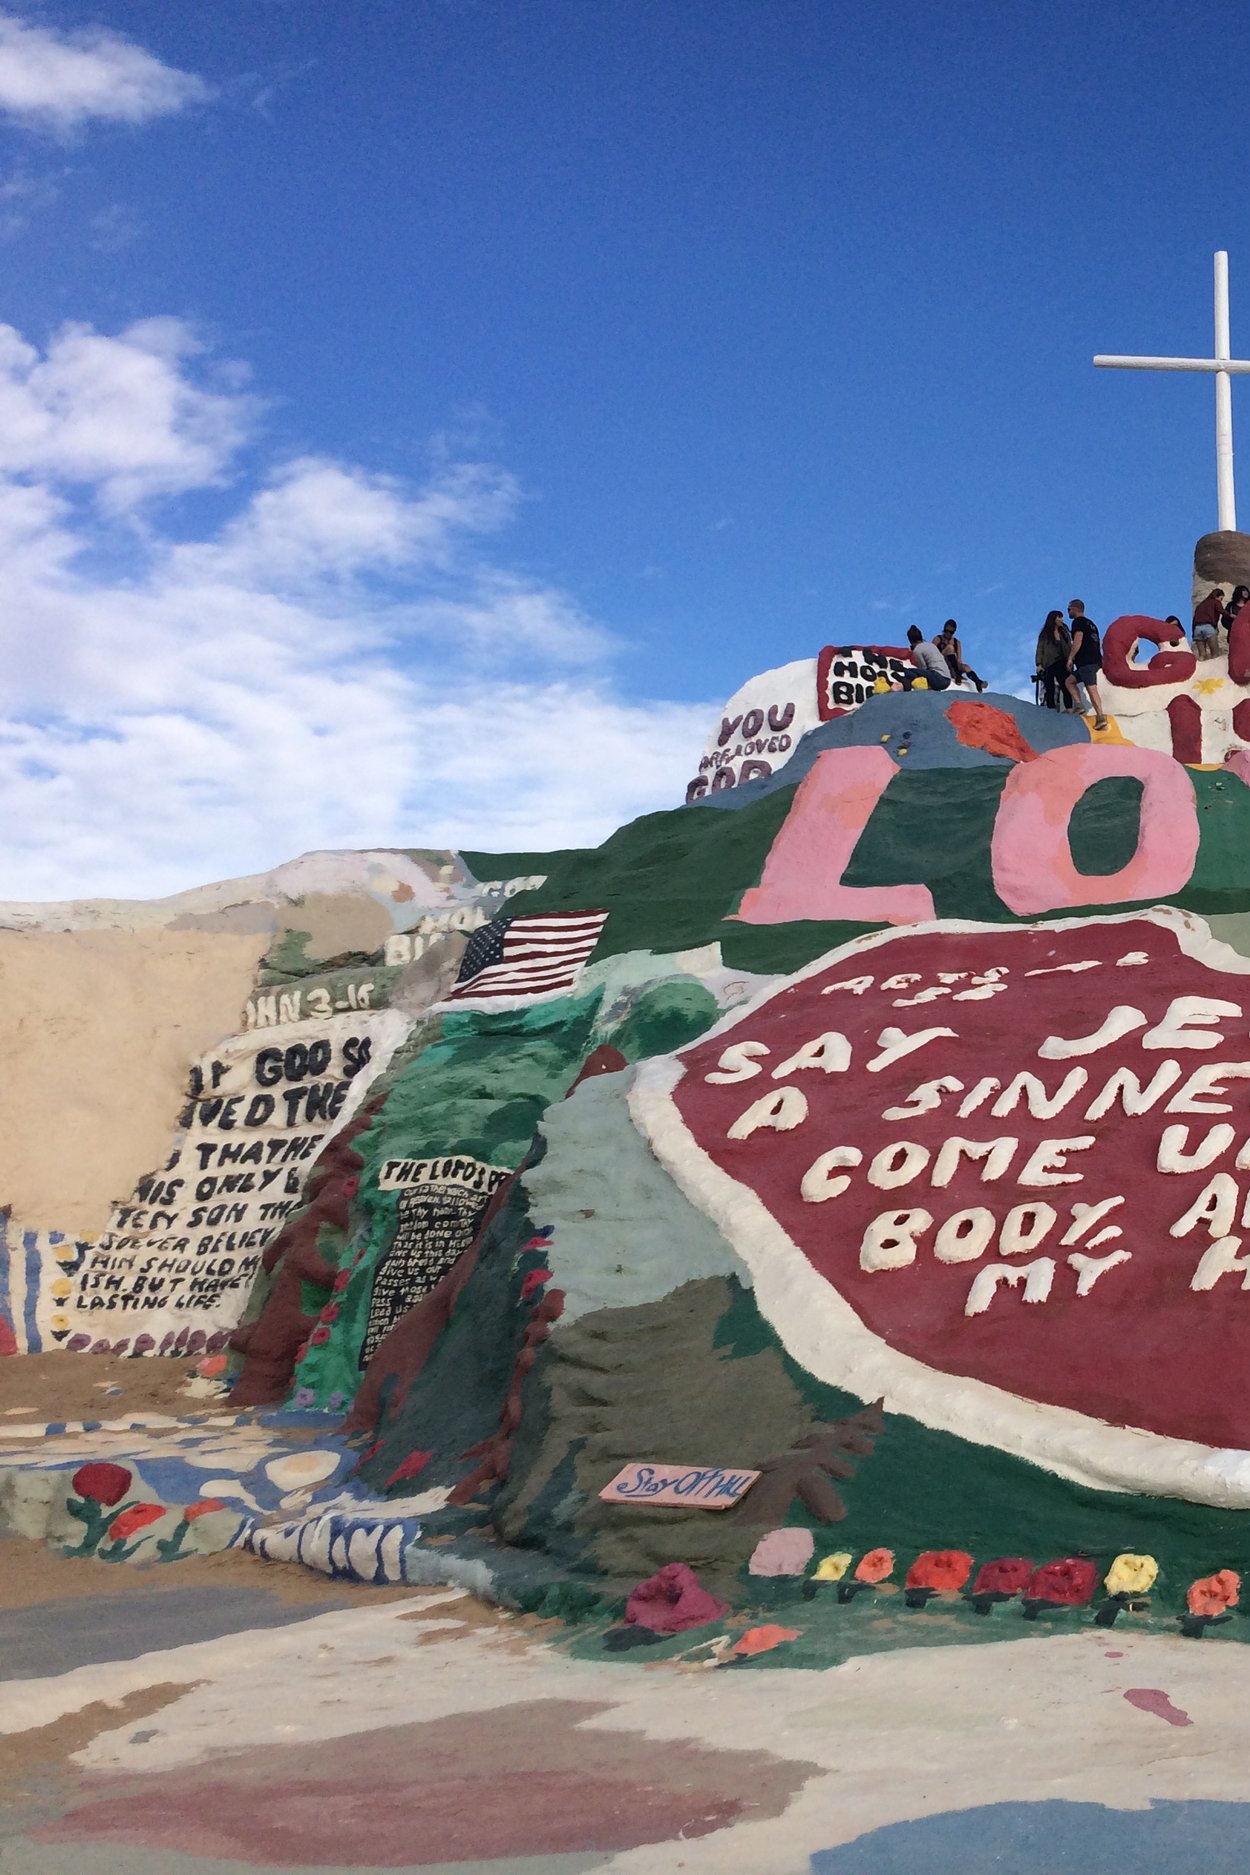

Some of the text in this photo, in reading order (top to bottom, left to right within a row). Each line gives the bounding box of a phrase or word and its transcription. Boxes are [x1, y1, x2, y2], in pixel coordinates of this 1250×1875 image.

[717, 702, 796, 747] YOU
[731, 733, 792, 758] LOVED
[704, 1025, 960, 1086] SAY
[726, 1085, 810, 1140] A
[384, 1160, 428, 1183] THE
[800, 1134, 1097, 1203] COME
[194, 1167, 283, 1202] ONLY
[186, 1201, 249, 1229] SON
[139, 1255, 236, 1278] SHOULD
[131, 1272, 186, 1294] BUT
[964, 1249, 1133, 1319] MY
[75, 1294, 169, 1311] LASTING
